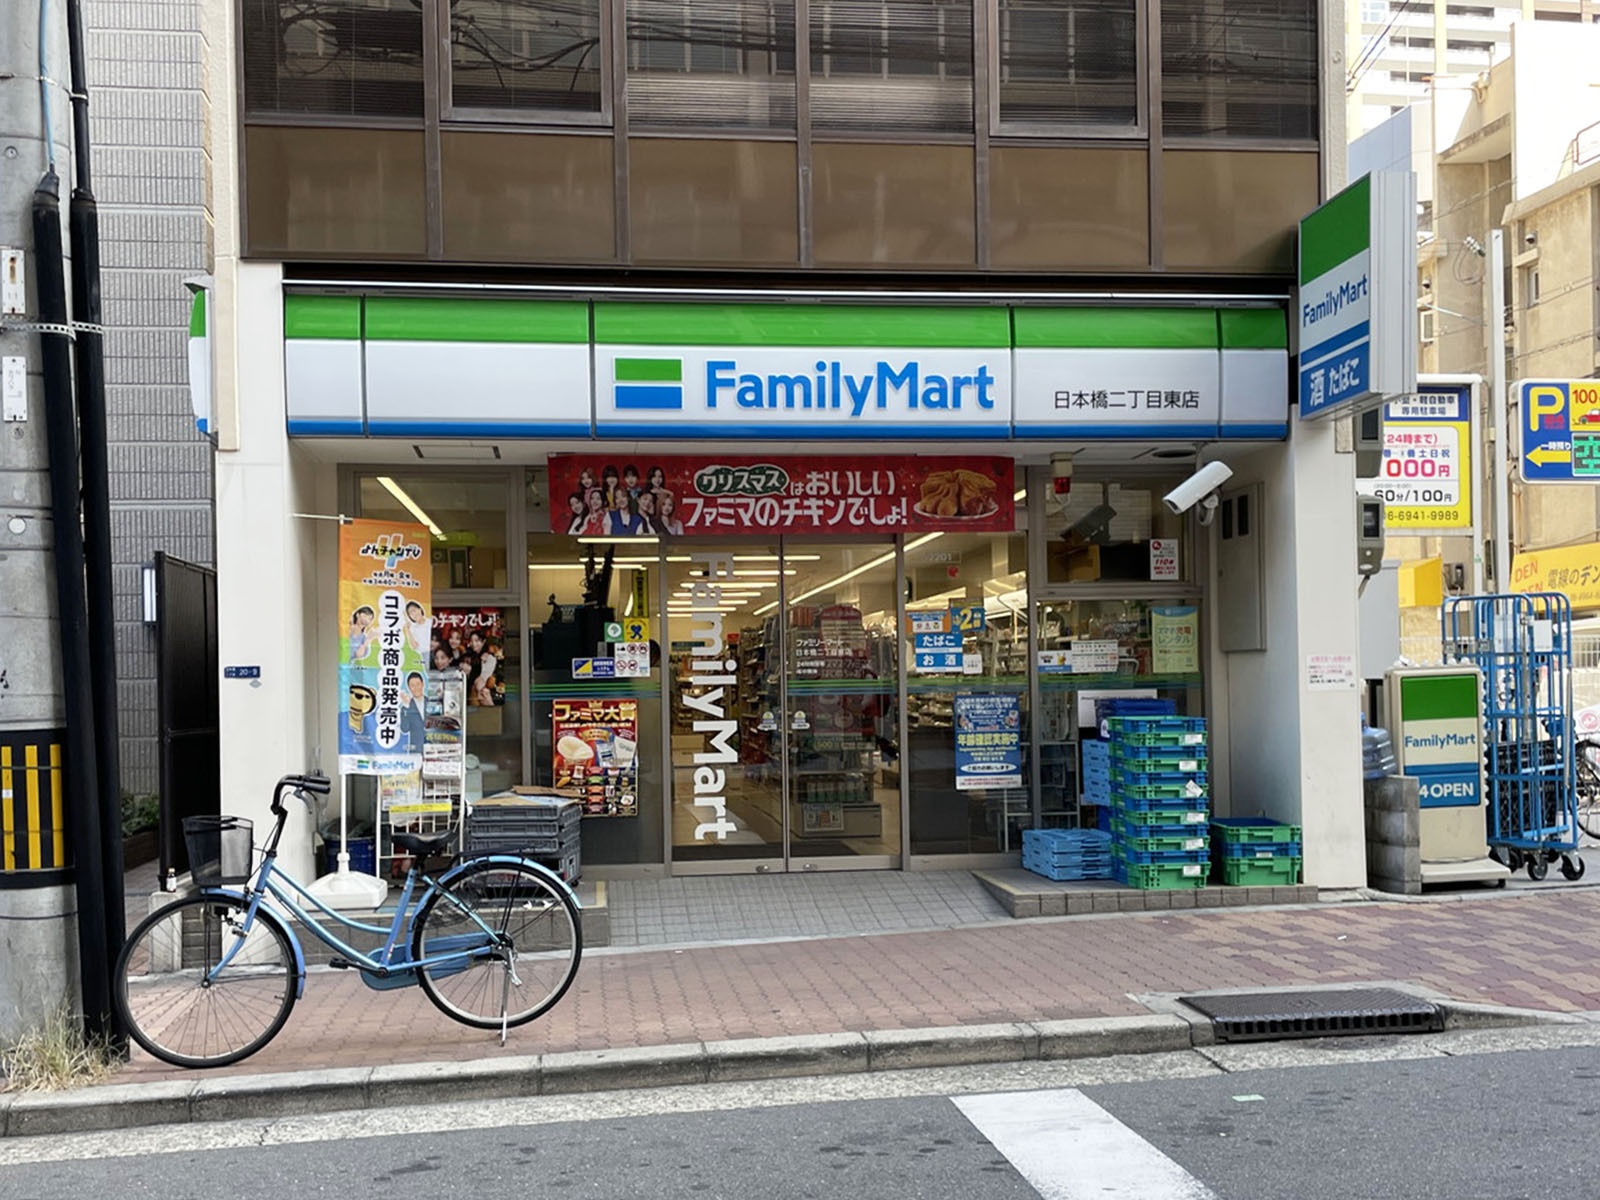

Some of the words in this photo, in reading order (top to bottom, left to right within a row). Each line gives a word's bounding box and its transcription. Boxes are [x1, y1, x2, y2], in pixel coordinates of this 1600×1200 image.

[1303, 273, 1367, 328] FamilyMart
[706, 360, 994, 417] FamilyMart
[1310, 368, 1324, 406] 酒
[1329, 358, 1360, 396] たばこ
[1054, 390, 1200, 409] 日本橋二丁目東店
[1529, 386, 1565, 432] P
[1572, 389, 1600, 404] 100
[1386, 459, 1450, 478] 000円
[681, 497, 907, 526] ファミマのチキンでしょ!
[1384, 511, 1459, 521] 6-6941-9989
[1515, 560, 1538, 583] DEN
[922, 635, 956, 647] たばこ
[379, 595, 401, 745] コラボ商品発売中
[681, 552, 738, 841] FamilyMart
[1405, 733, 1476, 749] FamilyMart
